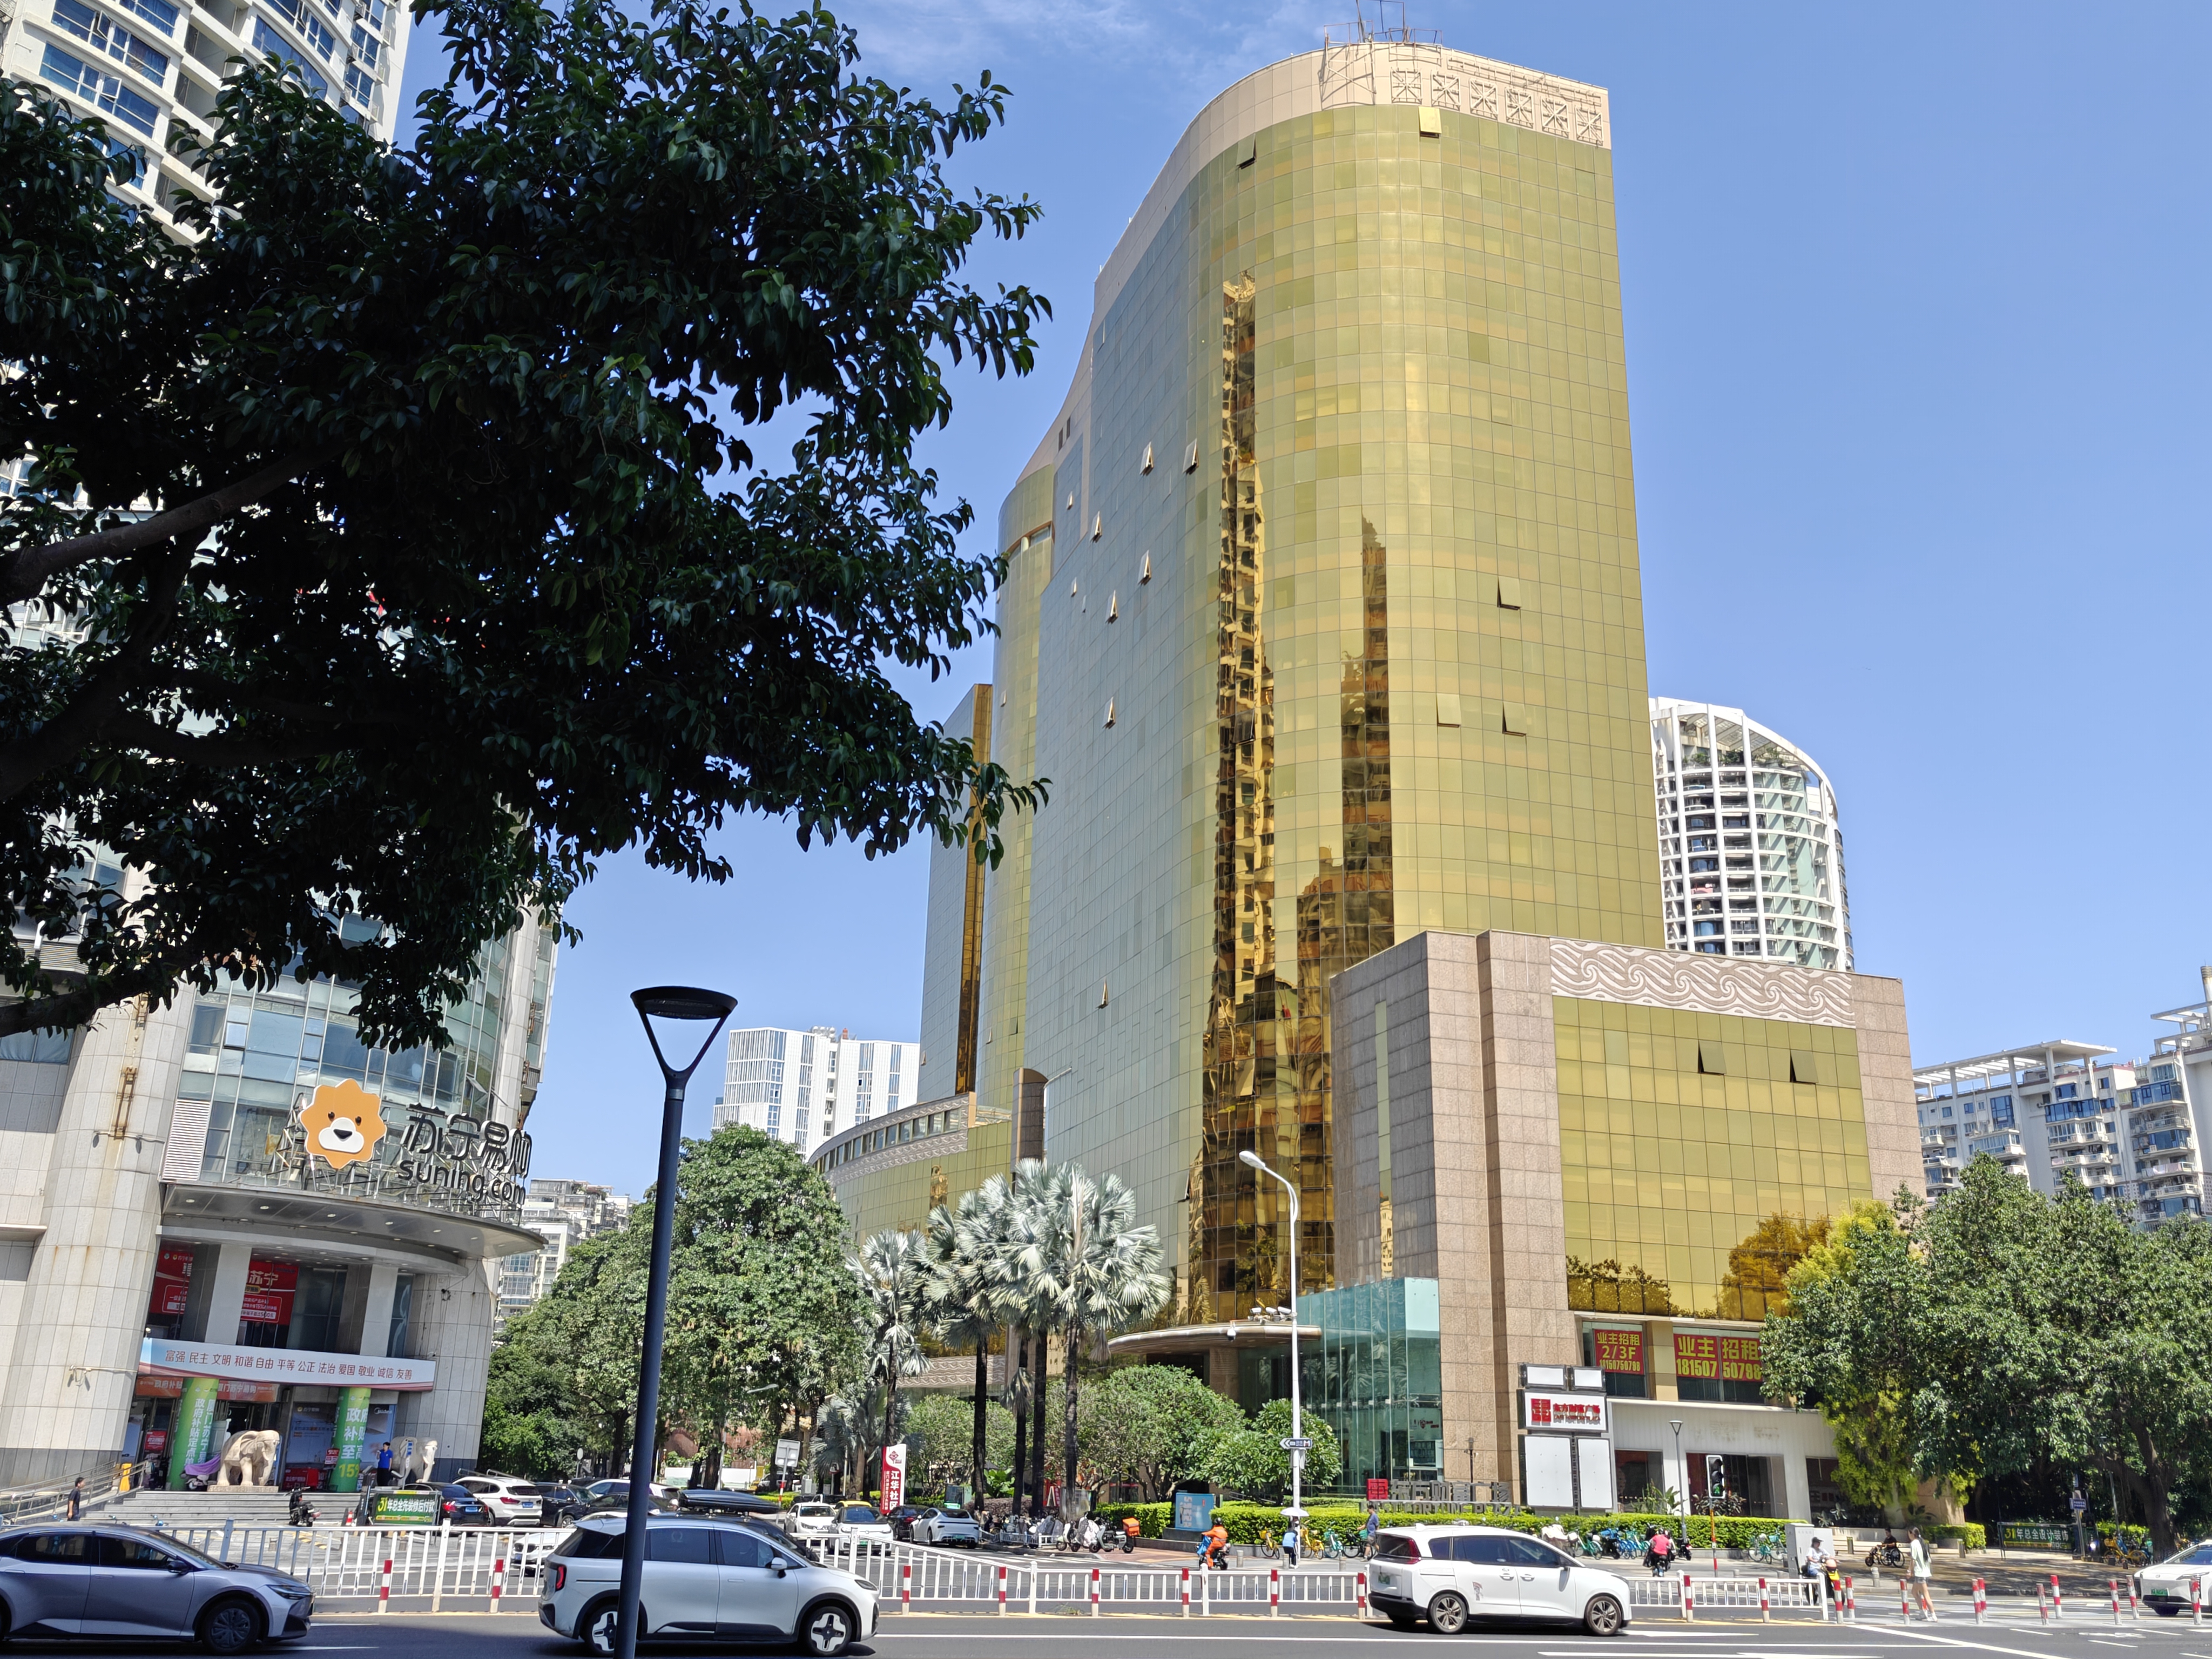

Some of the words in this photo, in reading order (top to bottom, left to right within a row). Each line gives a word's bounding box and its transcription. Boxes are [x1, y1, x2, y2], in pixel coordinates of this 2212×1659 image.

[400, 1102, 532, 1178] 苏宁易购
[395, 1160, 525, 1205] suning.com
[1597, 1332, 1640, 1346] 业主招租
[1677, 1336, 1716, 1358] 业主
[1722, 1339, 1759, 1361] 招租
[1602, 1345, 1636, 1360] 2/3F
[165, 1350, 186, 1363] 富强
[189, 1352, 209, 1364] 民主
[211, 1353, 231, 1366] 文明
[234, 1355, 254, 1368] 和谐
[255, 1357, 274, 1370] 自由
[276, 1359, 295, 1371] 平等
[298, 1360, 315, 1373] 公正
[318, 1362, 336, 1374] 法治
[338, 1364, 355, 1375] 爱国
[358, 1365, 375, 1377] 敬业
[377, 1366, 394, 1378] 诚信
[395, 1368, 413, 1380] 友善
[1599, 1359, 1641, 1372] 18150750798
[1676, 1358, 1717, 1378] 181507
[1723, 1362, 1762, 1380] 50798
[889, 1470, 900, 1510] 江华社区
[1390, 1479, 1512, 1502] 东方财富广场
[2005, 1528, 2069, 1542] 31年总全设计装饰
